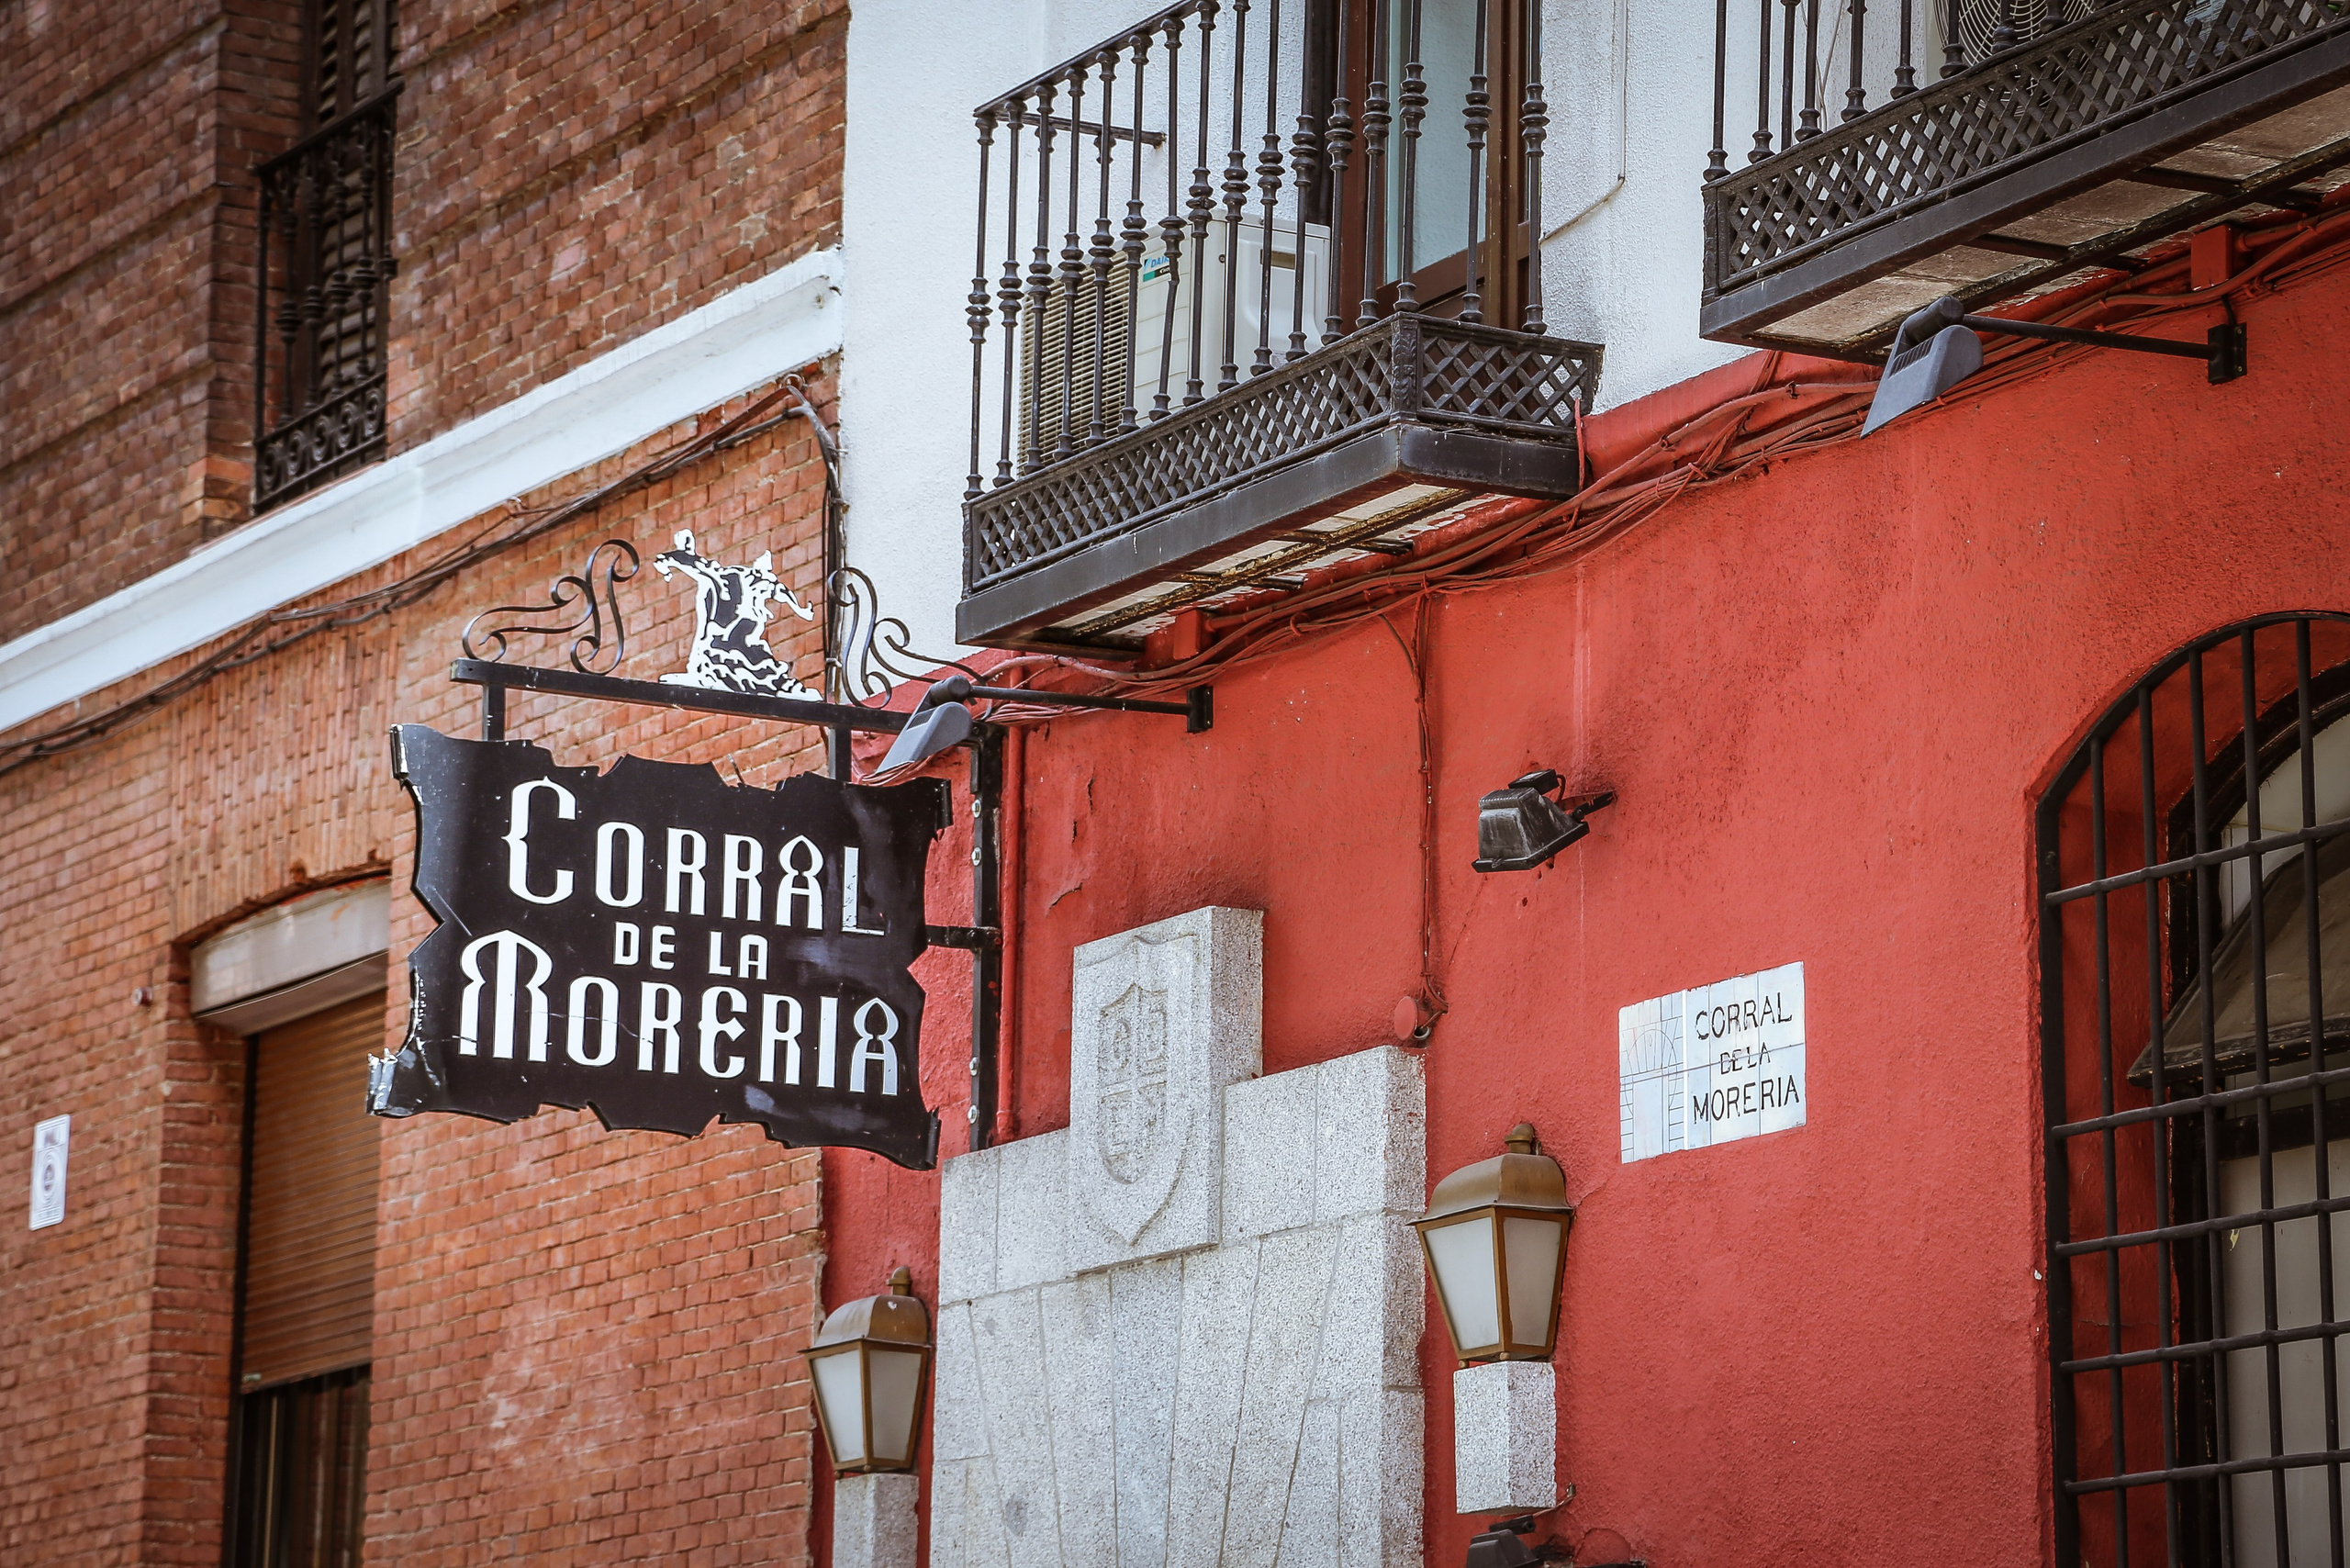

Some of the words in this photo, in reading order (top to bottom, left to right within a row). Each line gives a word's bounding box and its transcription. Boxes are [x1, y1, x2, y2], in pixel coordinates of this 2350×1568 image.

[1151, 255, 1169, 268] DAIK
[501, 776, 885, 935] CORRAL
[612, 921, 677, 970] DE
[708, 931, 769, 981] LA
[458, 929, 900, 1096] MORERIA
[1695, 992, 1792, 1040] CORRAL
[1693, 1074, 1800, 1125] MORERIA
